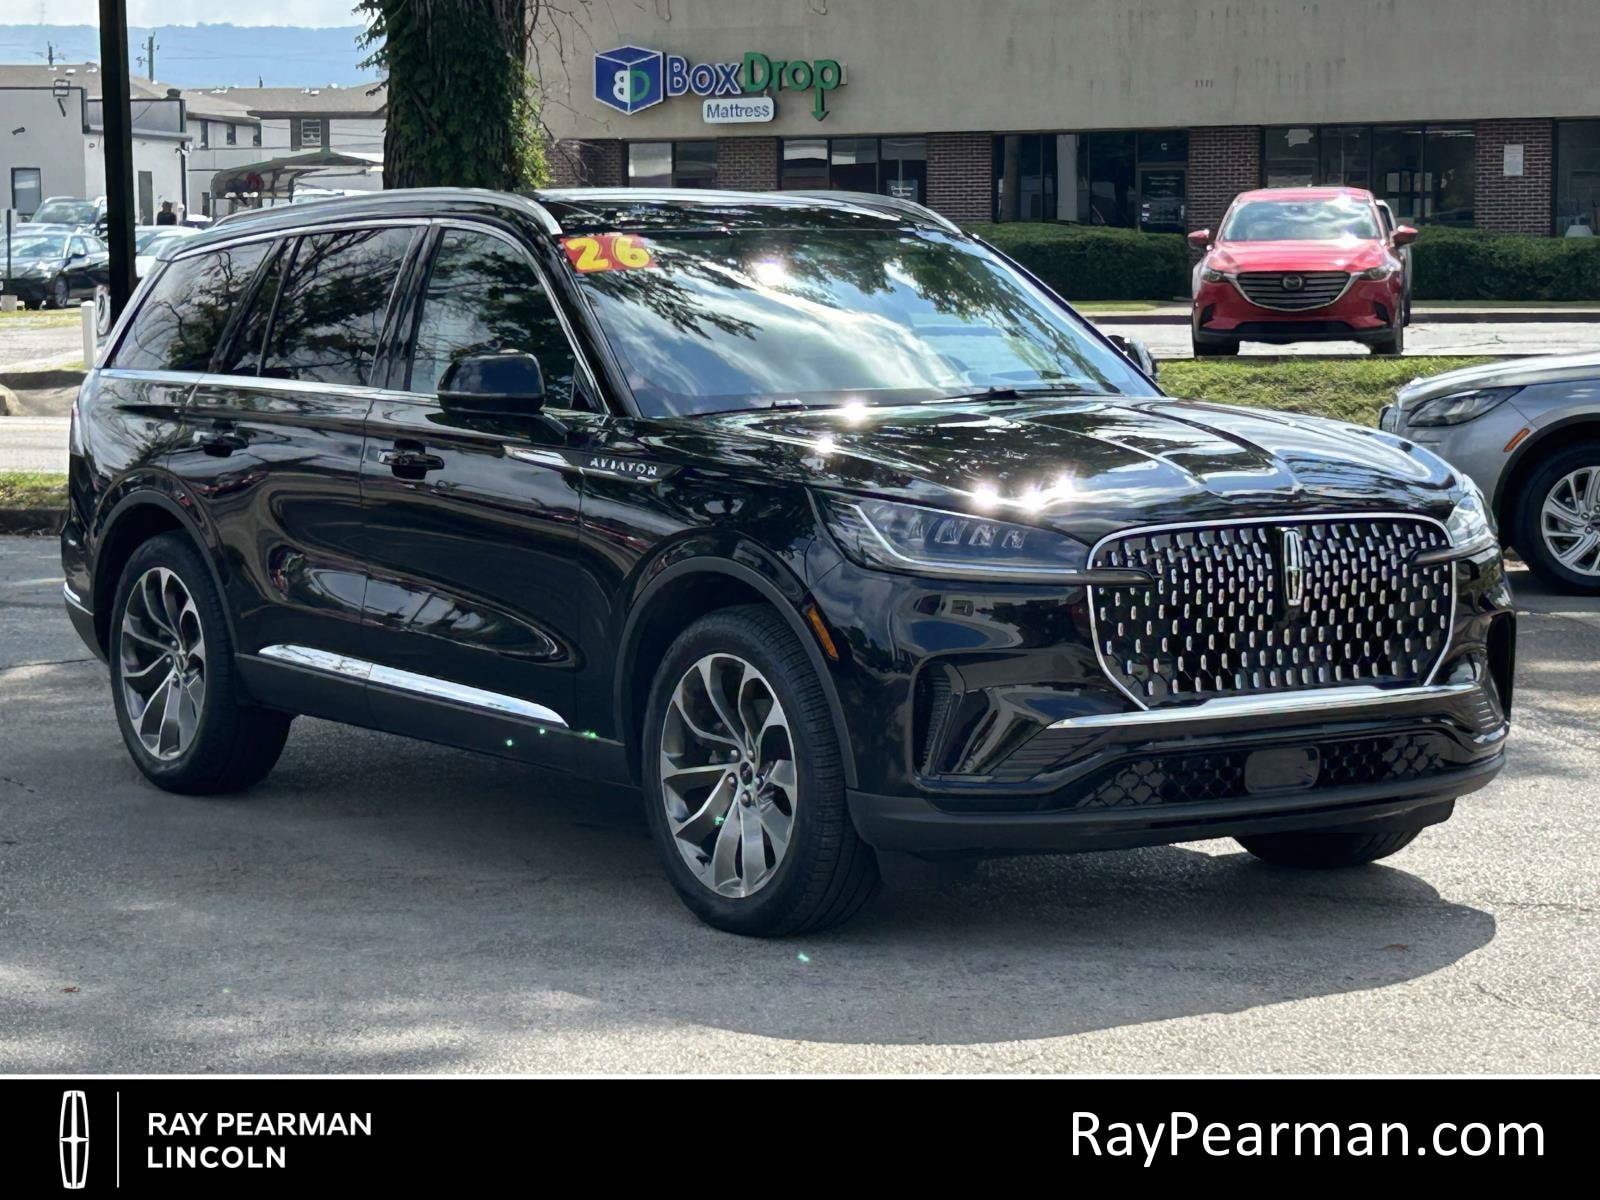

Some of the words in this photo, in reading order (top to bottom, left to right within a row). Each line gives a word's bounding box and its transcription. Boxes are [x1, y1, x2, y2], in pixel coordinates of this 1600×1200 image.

[667, 52, 842, 121] BoxDrop
[706, 103, 770, 119] Mattress
[565, 237, 650, 271] 26
[590, 457, 658, 476] AVIATOR
